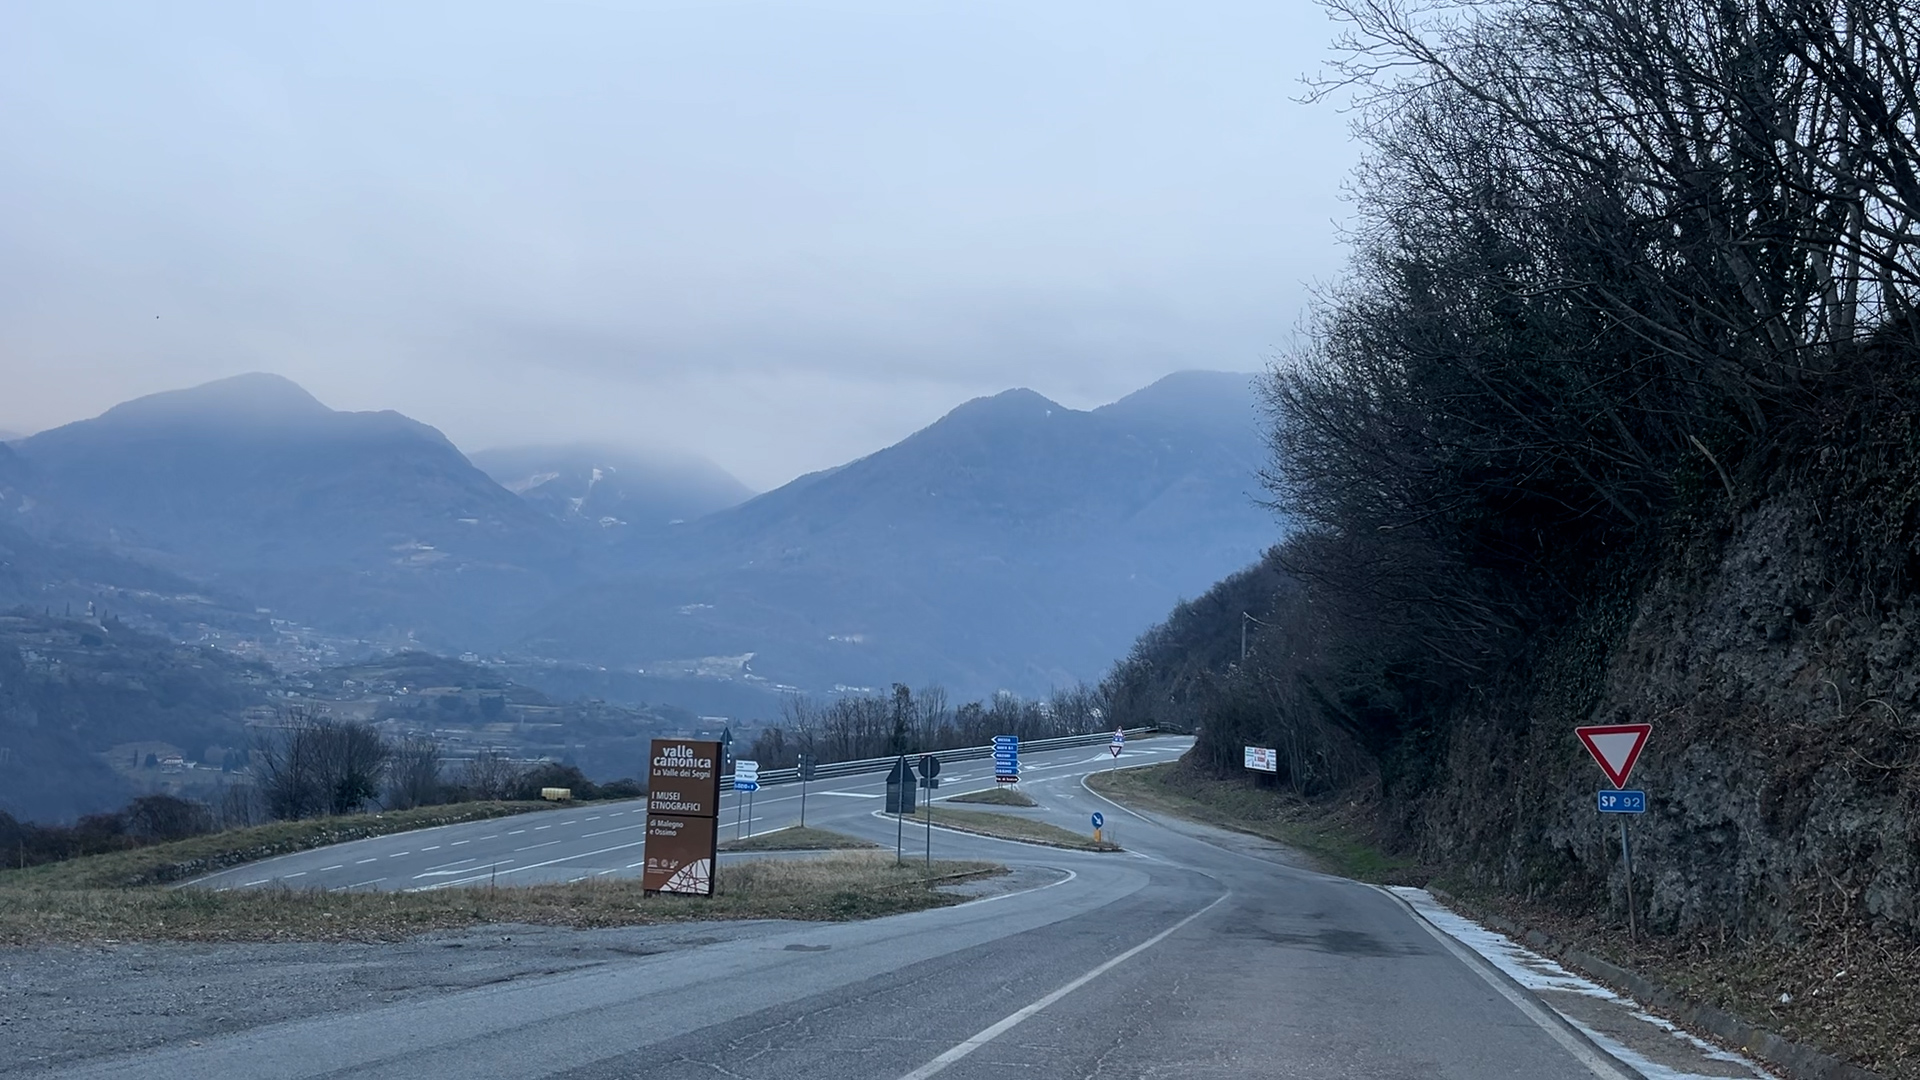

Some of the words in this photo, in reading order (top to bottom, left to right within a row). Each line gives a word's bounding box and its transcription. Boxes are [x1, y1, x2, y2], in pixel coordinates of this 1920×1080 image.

[663, 745, 693, 757] valle
[654, 756, 711, 768] camonica
[679, 769, 691, 777] dei
[691, 770, 711, 780] Segni
[656, 791, 680, 801] MUSEI
[1601, 795, 1617, 807] SP
[1623, 797, 1641, 808] 92
[651, 801, 700, 811] ETNOGRAFICI
[650, 819, 656, 827] di
[657, 820, 684, 829] Malegno
